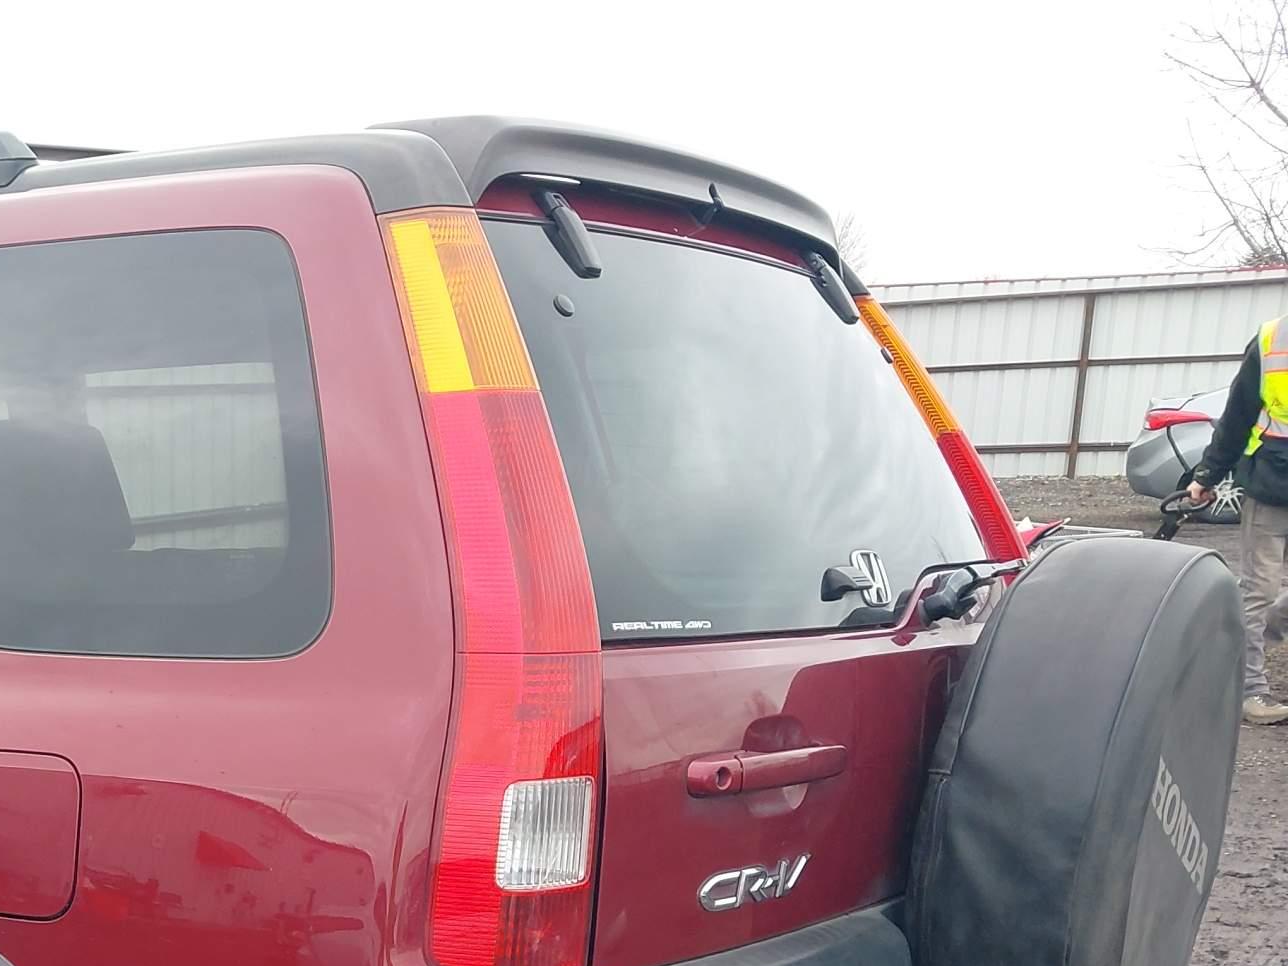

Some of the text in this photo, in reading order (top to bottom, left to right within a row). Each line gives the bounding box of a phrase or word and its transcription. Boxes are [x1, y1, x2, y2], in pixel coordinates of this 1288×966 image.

[612, 620, 712, 631] REALTIME 4WD
[1152, 755, 1209, 894] HONDA
[696, 852, 812, 911] CR-V
